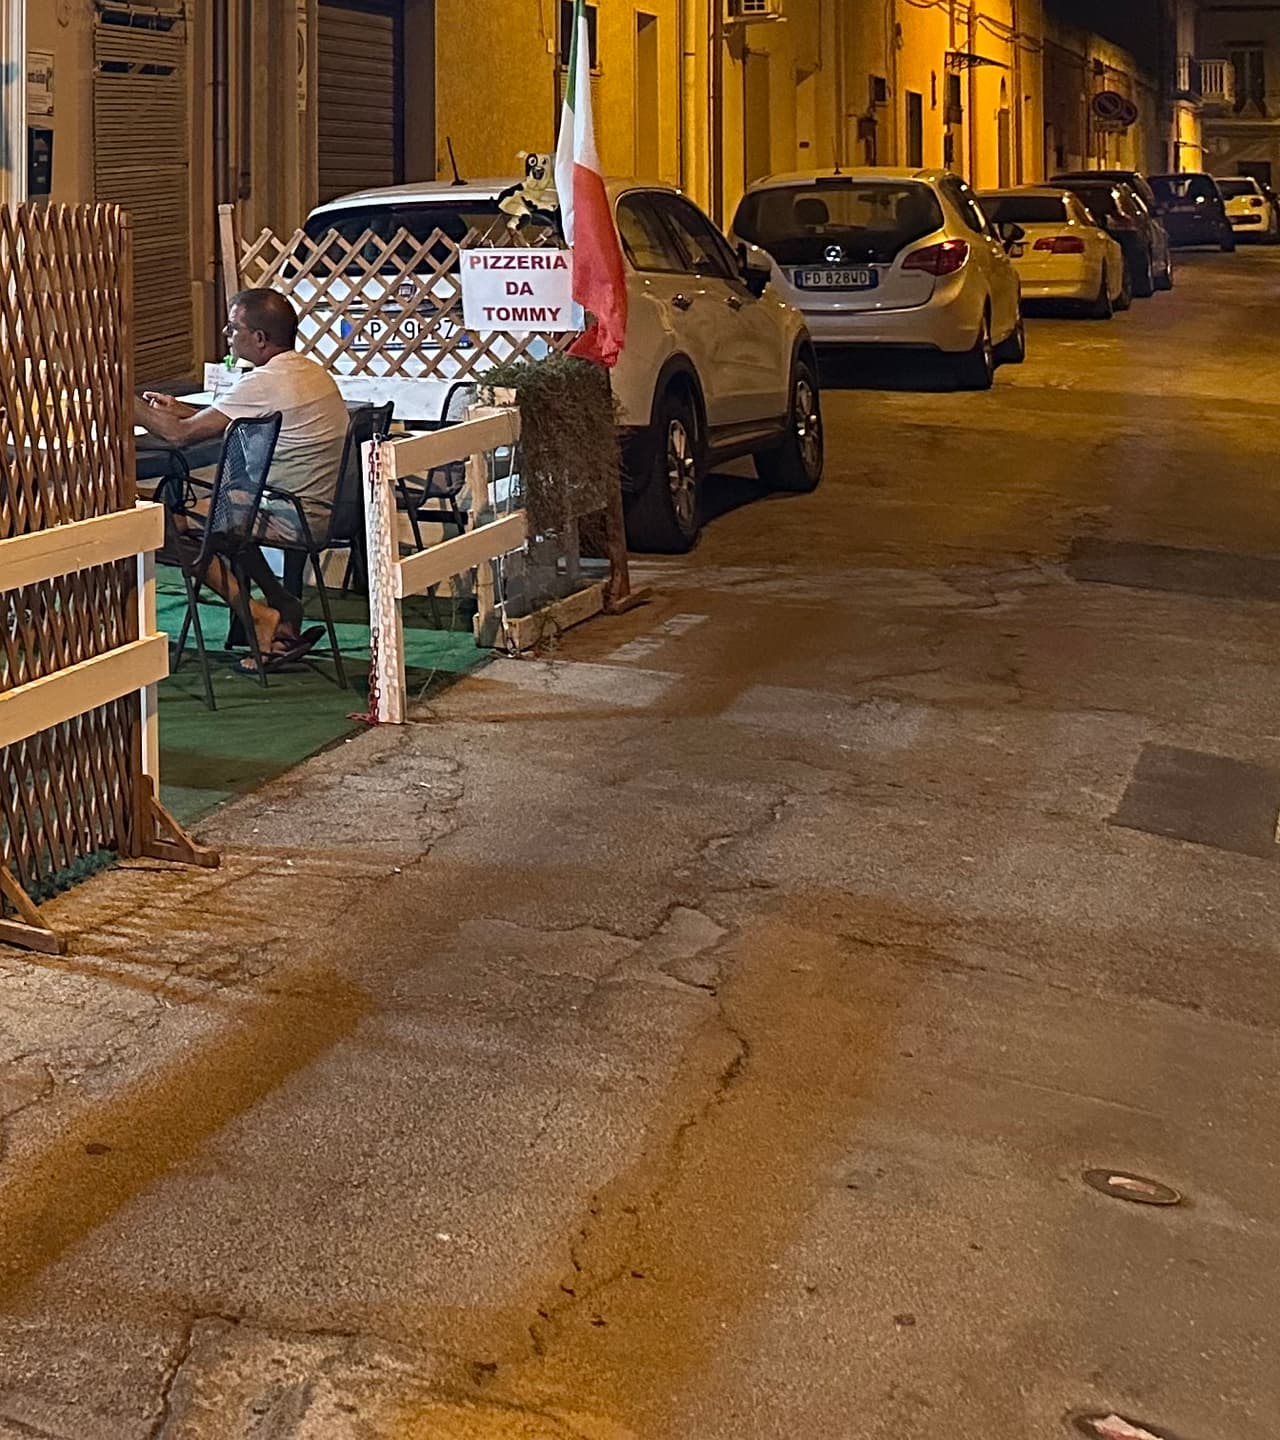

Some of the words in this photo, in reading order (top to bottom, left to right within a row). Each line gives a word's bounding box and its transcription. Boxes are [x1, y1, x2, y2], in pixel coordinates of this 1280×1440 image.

[469, 255, 568, 270] PIZZERIA
[506, 281, 534, 296] DA
[482, 307, 562, 321] TOMMY
